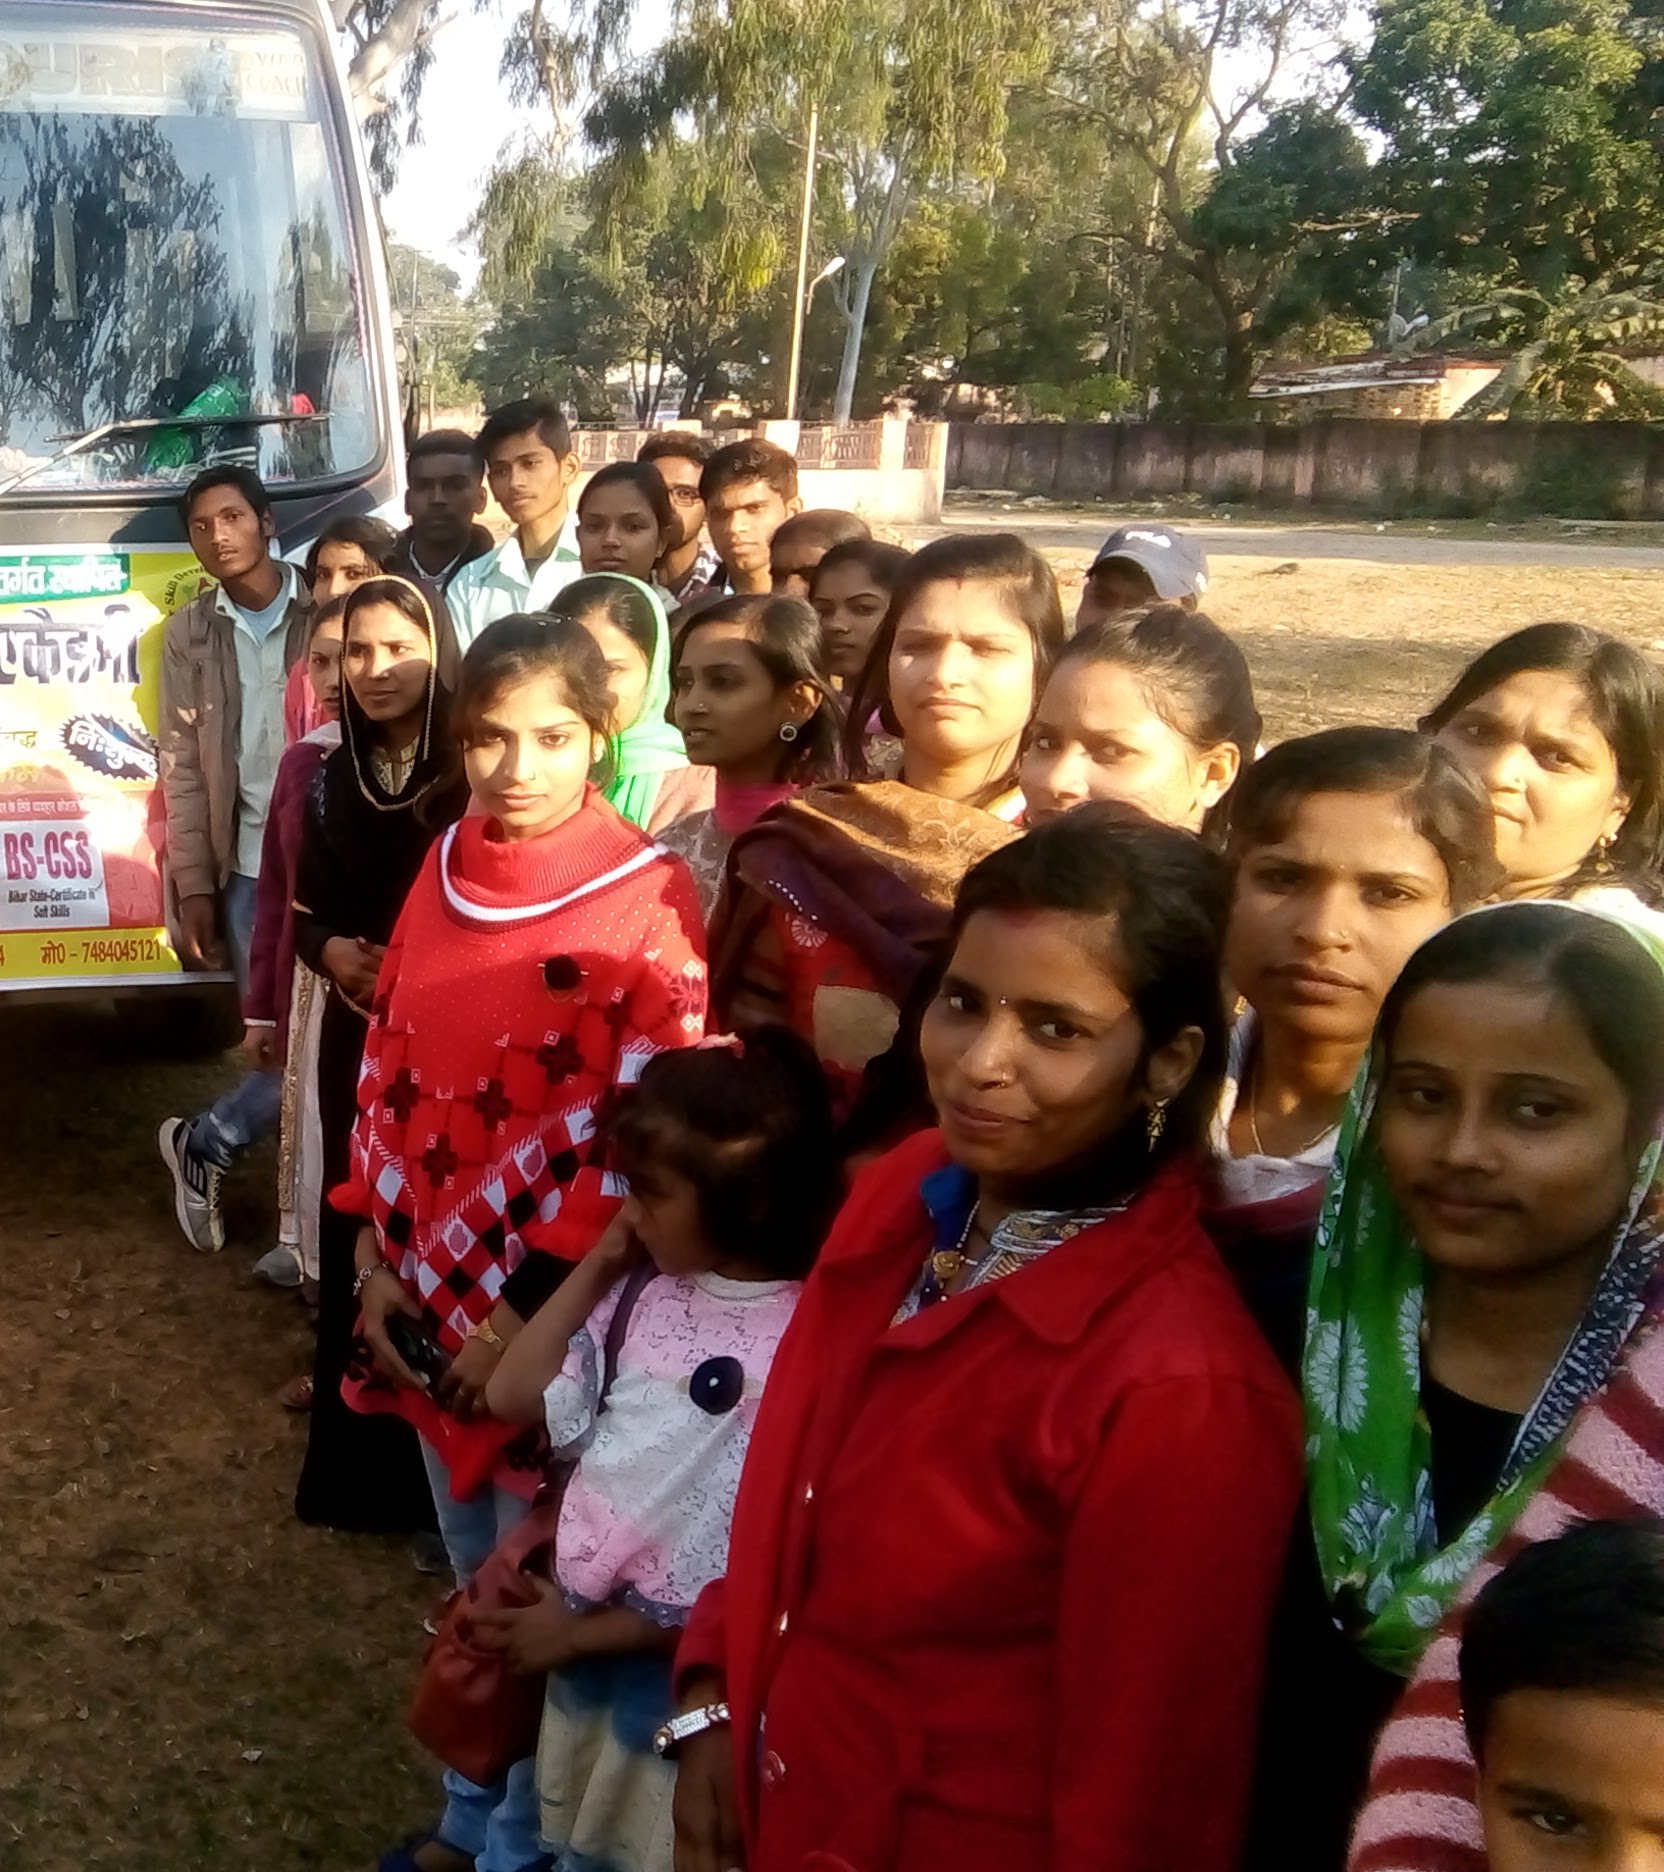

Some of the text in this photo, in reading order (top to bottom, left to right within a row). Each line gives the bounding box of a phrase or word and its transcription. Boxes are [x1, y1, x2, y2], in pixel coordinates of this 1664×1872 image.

[4, 830, 93, 880] BS-CSS
[8, 889, 27, 903] Bihar
[33, 903, 70, 918] Soft Skills
[81, 938, 161, 964] 7484045121
